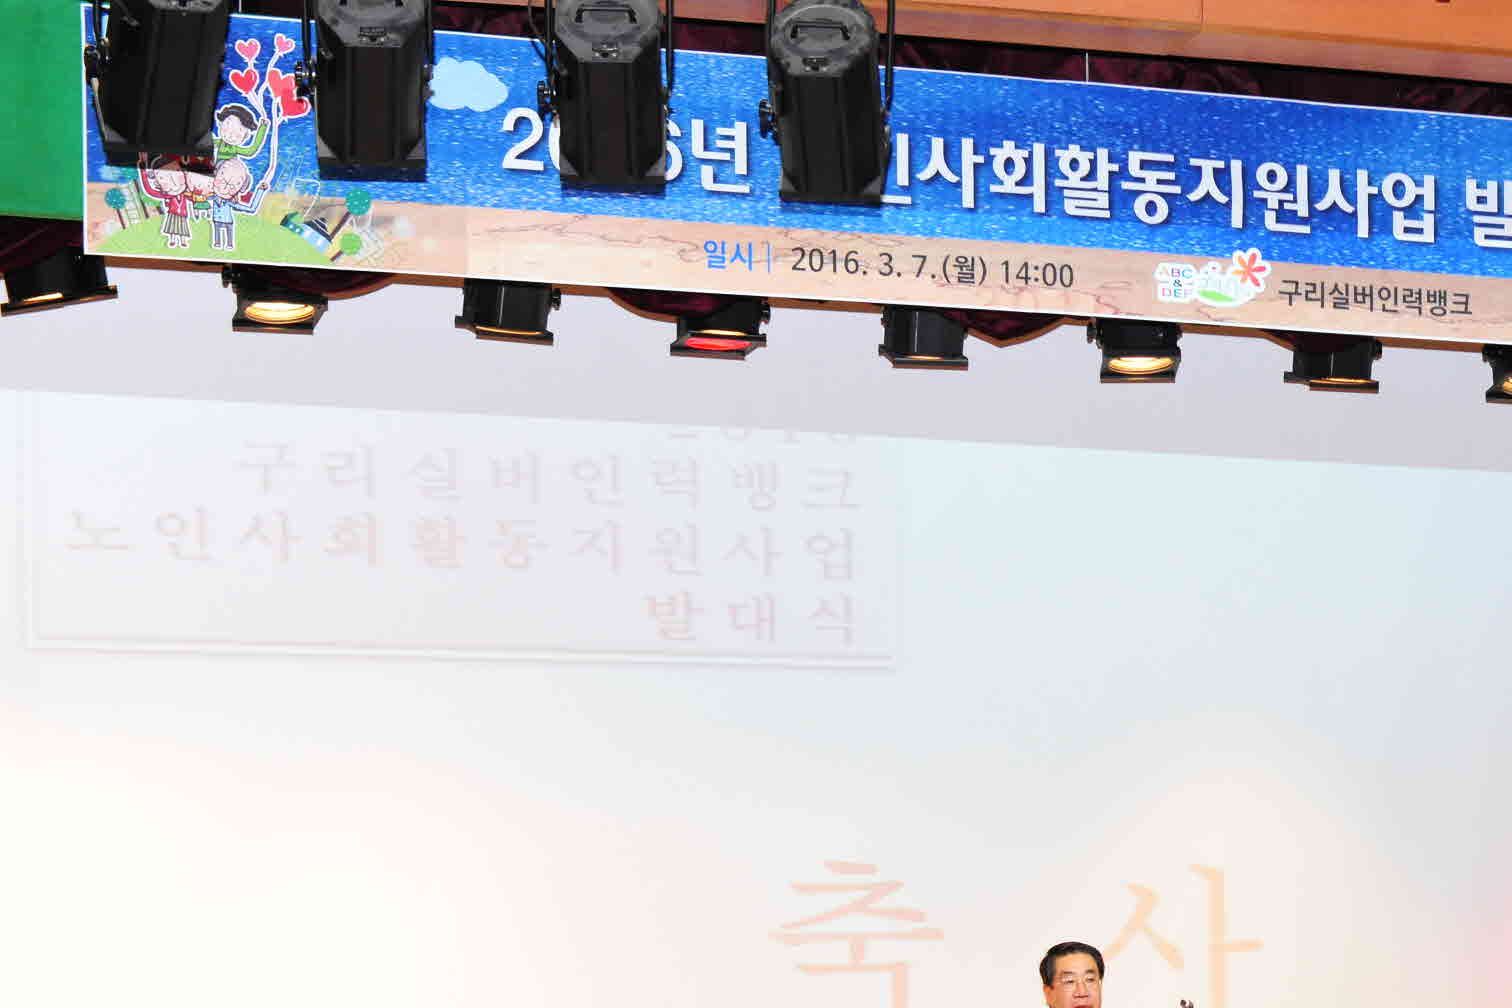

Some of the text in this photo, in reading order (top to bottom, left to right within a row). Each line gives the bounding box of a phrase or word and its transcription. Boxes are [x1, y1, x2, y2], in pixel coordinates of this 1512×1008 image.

[703, 240, 753, 272] 일시
[791, 247, 868, 275] 2016.
[1001, 260, 1074, 288] 14:00
[1278, 279, 1473, 317] 구리실버인력뱅크
